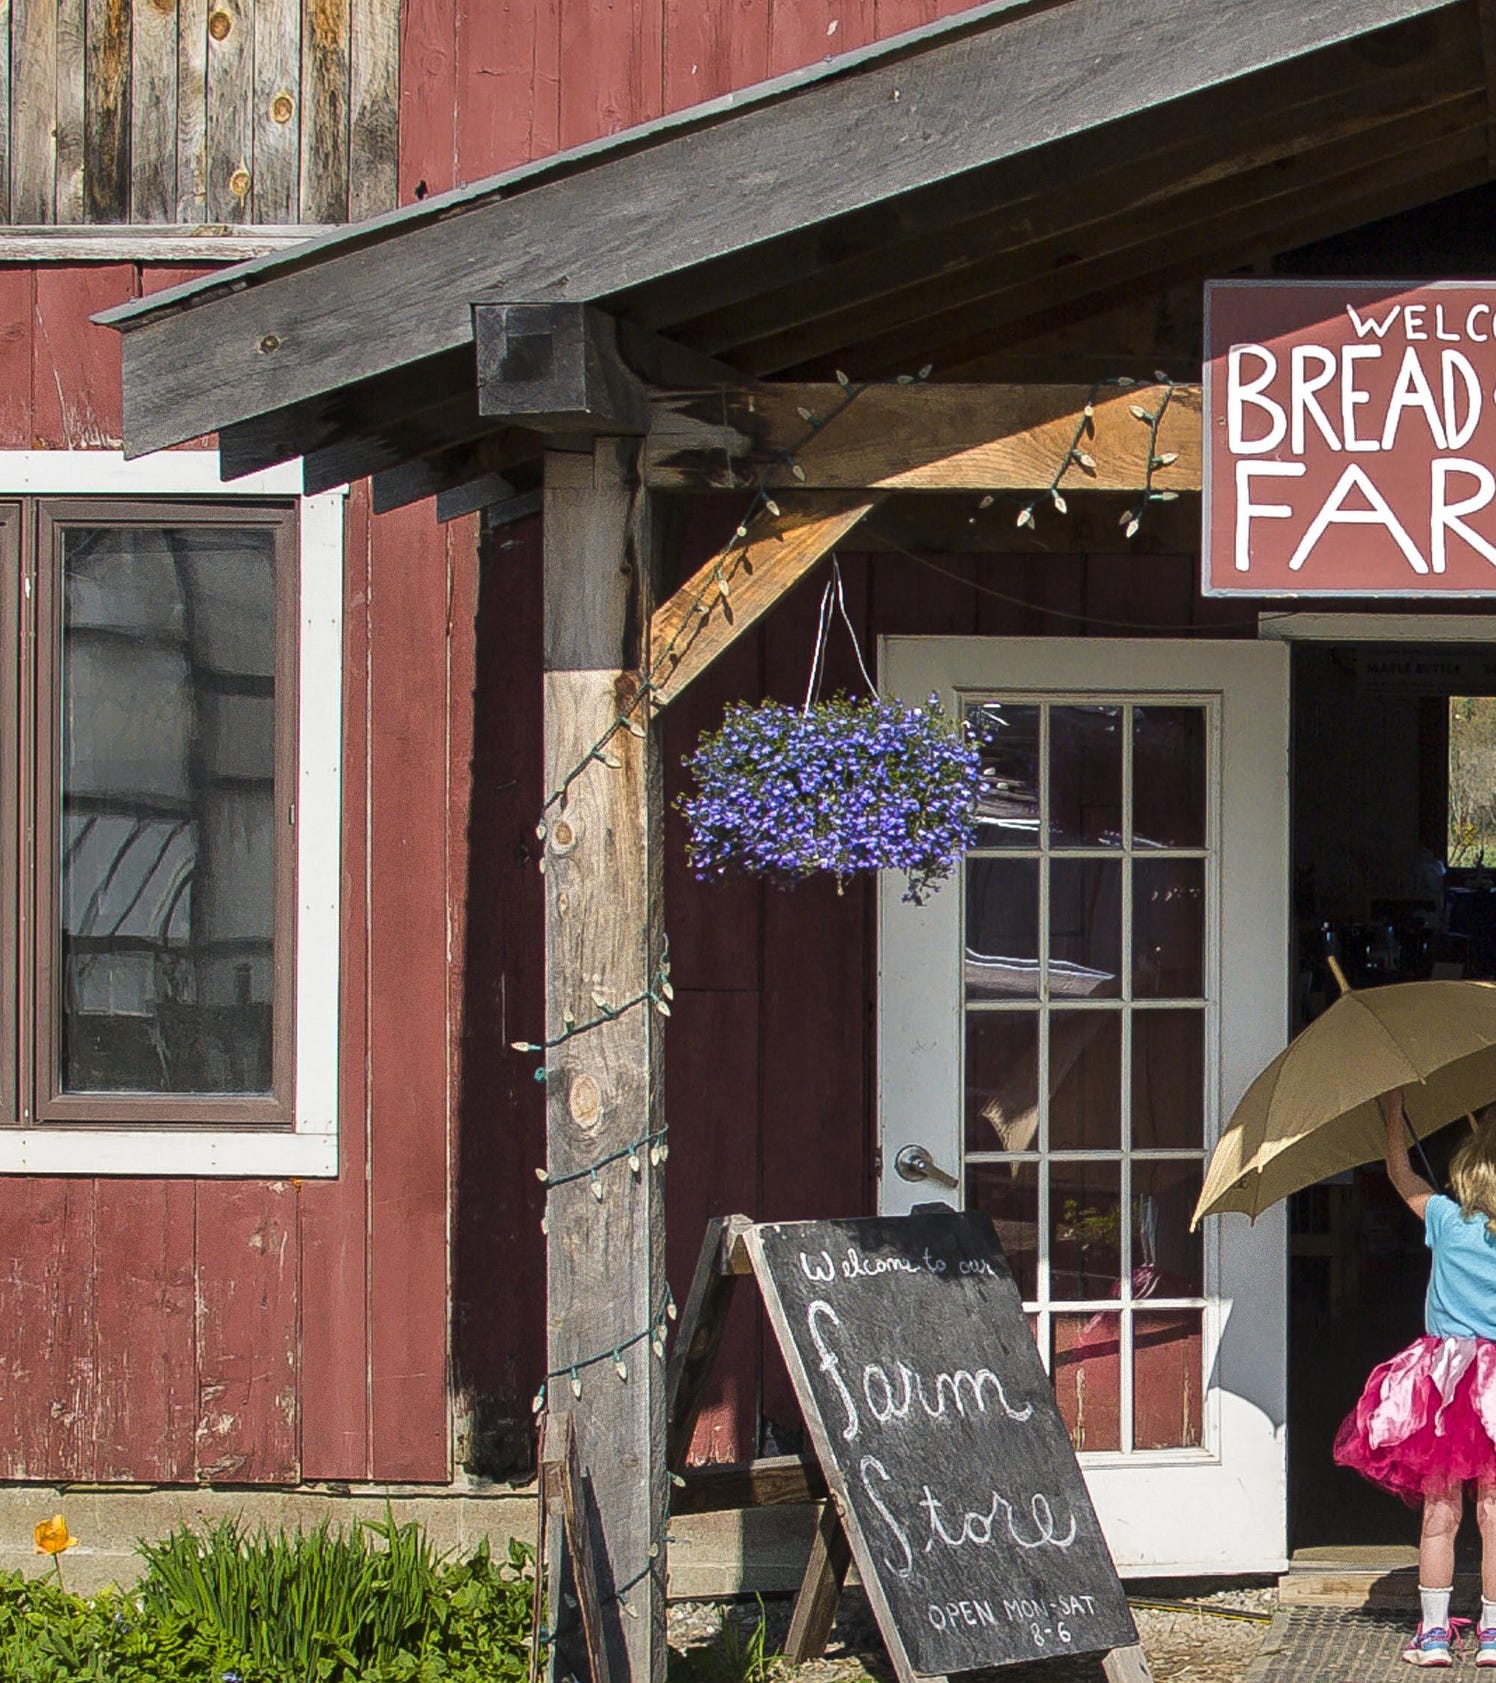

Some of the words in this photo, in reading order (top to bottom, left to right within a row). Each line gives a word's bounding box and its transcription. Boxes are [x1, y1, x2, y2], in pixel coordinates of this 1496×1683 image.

[1227, 343, 1484, 456] BREAD
[800, 1247, 921, 1282] Welcome
[922, 1246, 947, 1273] to
[958, 1257, 1000, 1279] our
[859, 1454, 1077, 1579] Store
[927, 1599, 999, 1631] OPEN
